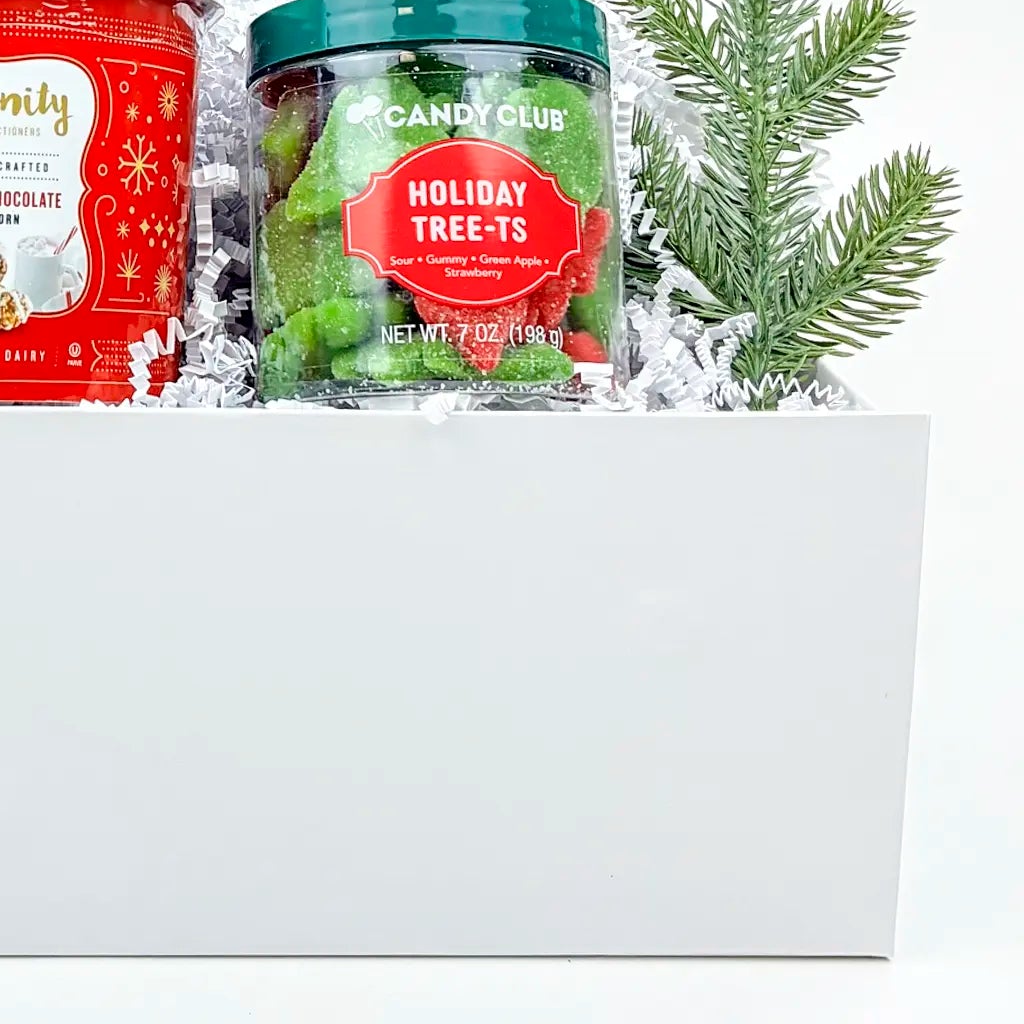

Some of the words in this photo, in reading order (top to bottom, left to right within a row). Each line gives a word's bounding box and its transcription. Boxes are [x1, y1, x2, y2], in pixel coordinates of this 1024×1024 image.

[384, 103, 492, 128] CANDY
[408, 180, 528, 208] HOLIDAY
[411, 215, 528, 244] TREE-TS
[390, 256, 415, 267] Sour
[426, 255, 469, 268] Gummy
[479, 254, 511, 265] Green
[513, 256, 543, 268] Apple
[444, 268, 503, 280] Strawberry
[381, 324, 416, 345] NET
[420, 322, 453, 344] WT.
[459, 324, 469, 343] 7
[475, 323, 505, 344] OZ.
[509, 322, 546, 347] (198
[549, 327, 564, 348] g)
[5, 349, 47, 363] DAIRY
